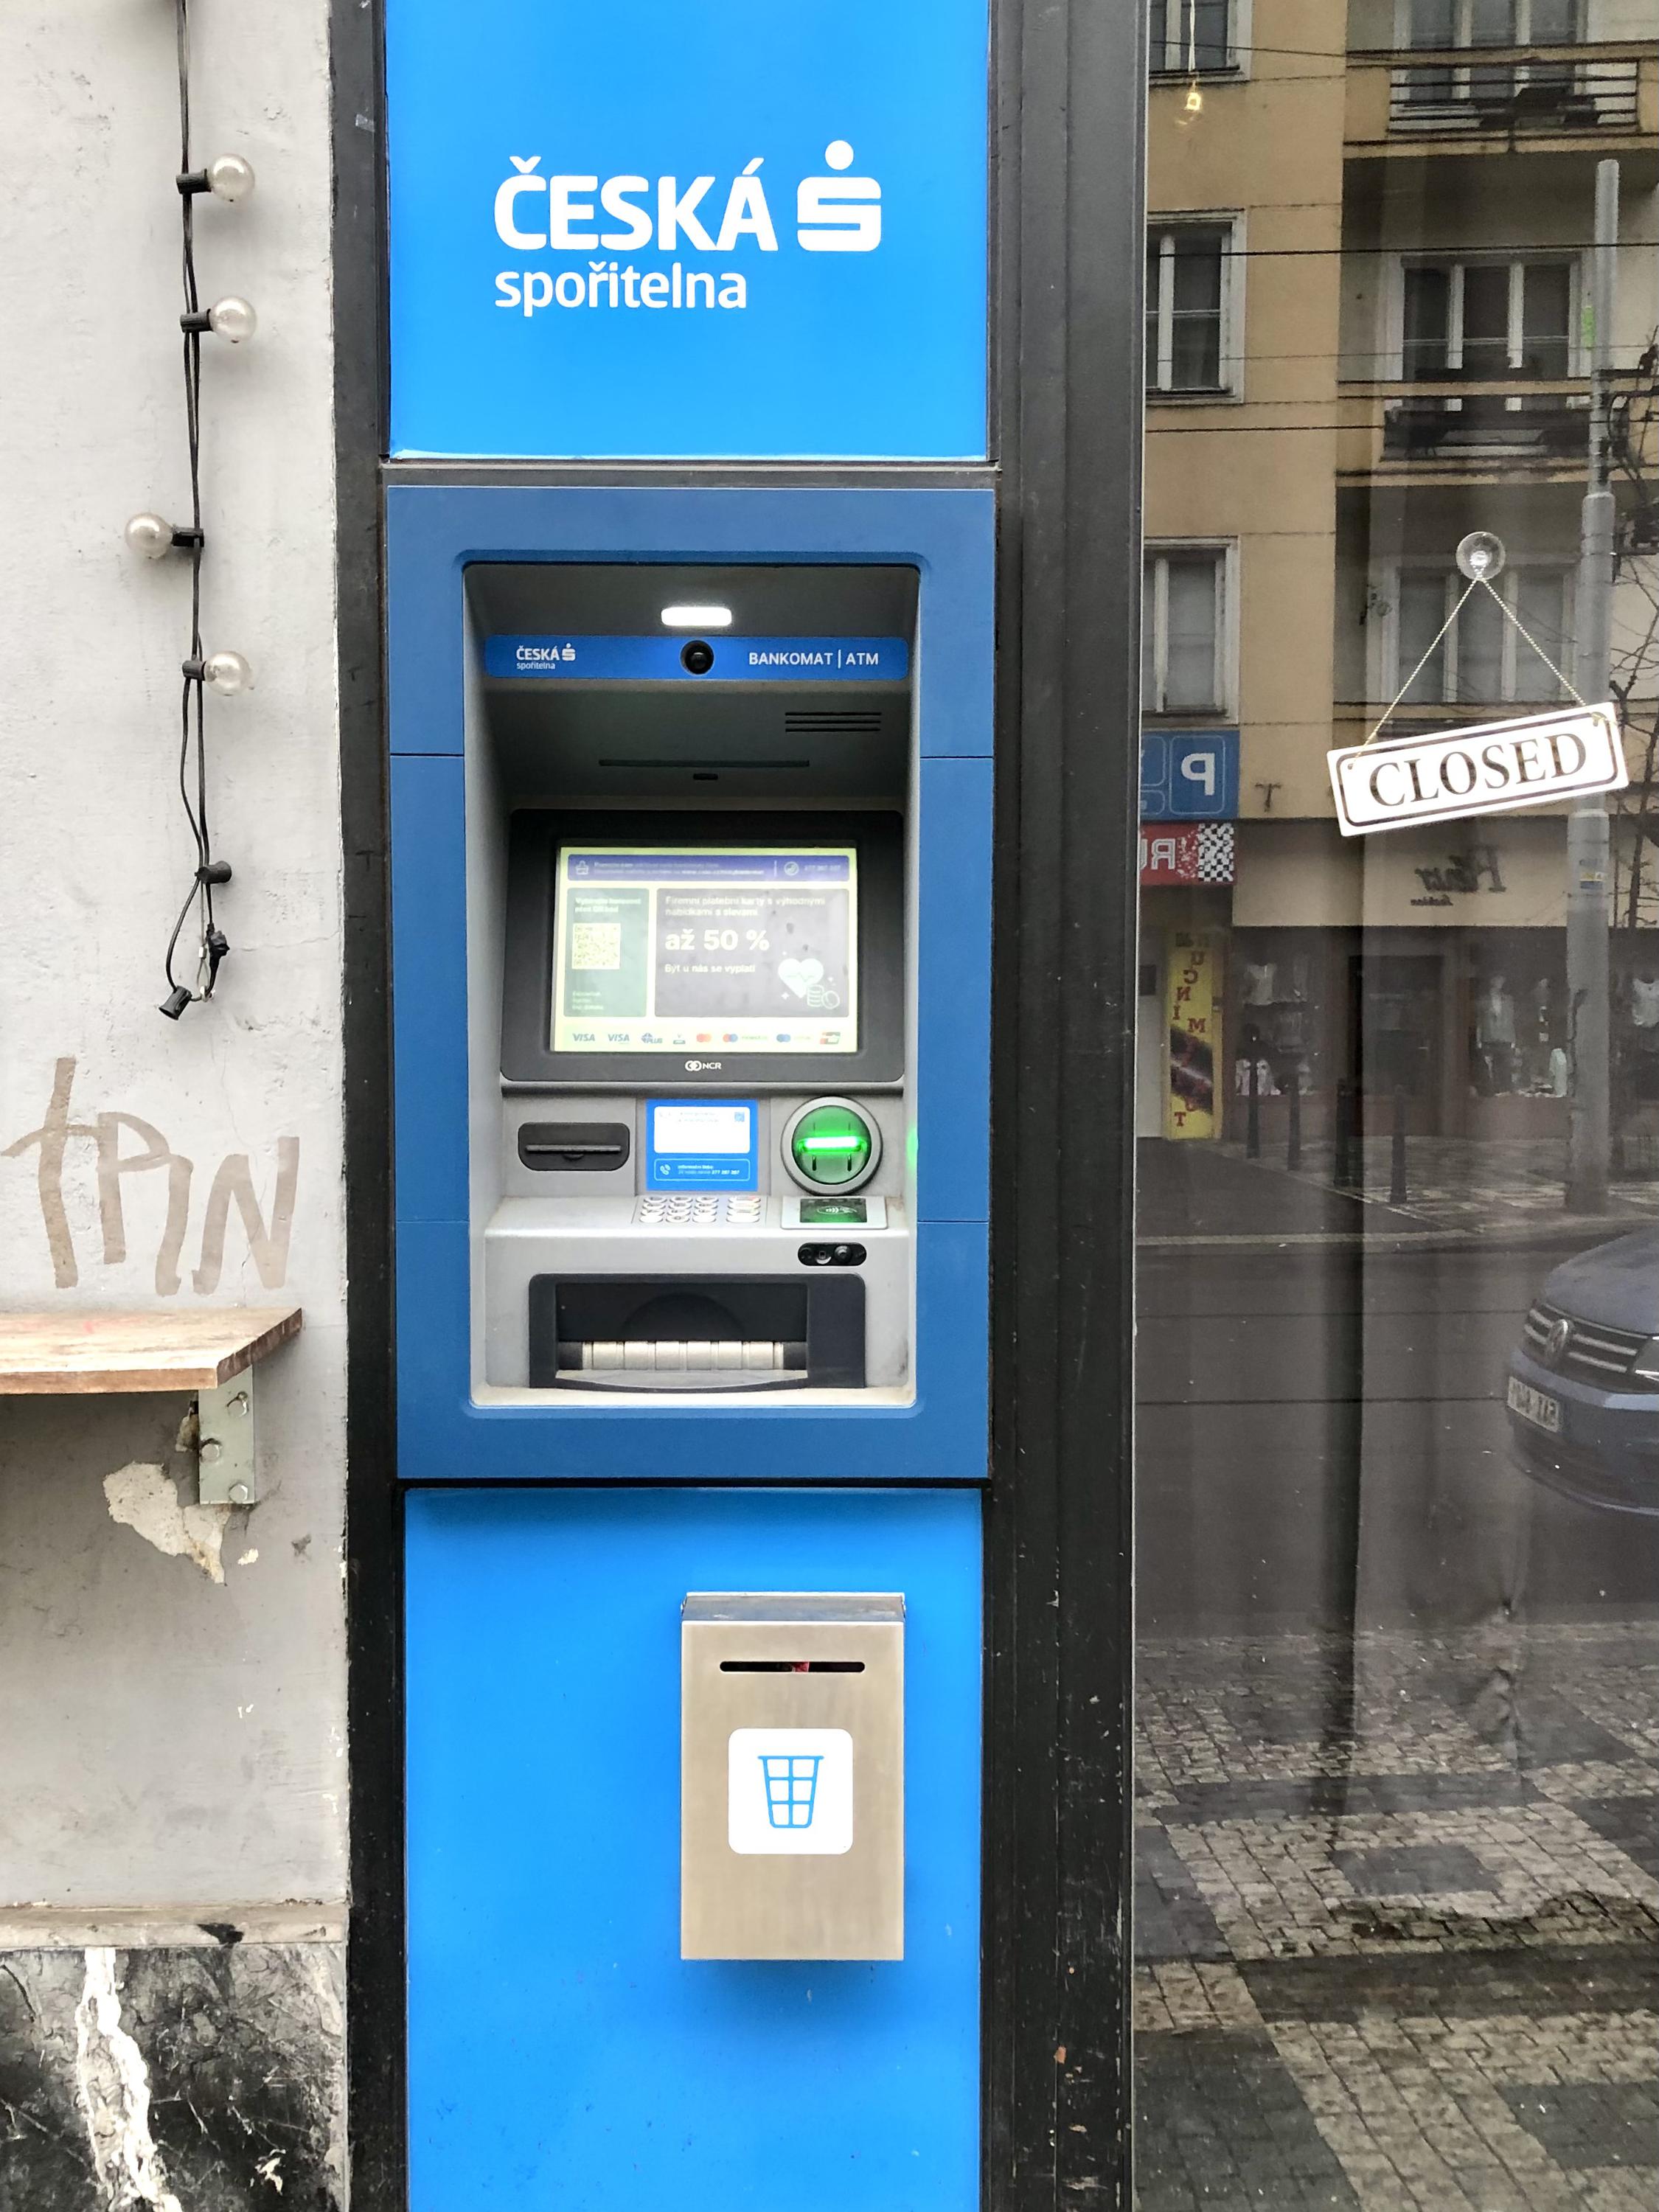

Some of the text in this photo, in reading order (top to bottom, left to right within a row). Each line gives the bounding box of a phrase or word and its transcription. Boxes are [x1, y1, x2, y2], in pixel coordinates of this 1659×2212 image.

[494, 156, 779, 251] ČESKÁ
[495, 261, 746, 317] spořitelna
[516, 645, 560, 661] ČESKÁ
[749, 653, 879, 665] BANKOMAT ATM
[1370, 733, 1587, 807] CLOSED
[665, 928, 770, 950] až 50 %
[684, 965, 690, 973] u
[711, 965, 723, 973] se
[572, 1033, 595, 1041] VISA
[703, 1062, 722, 1070] NCR
